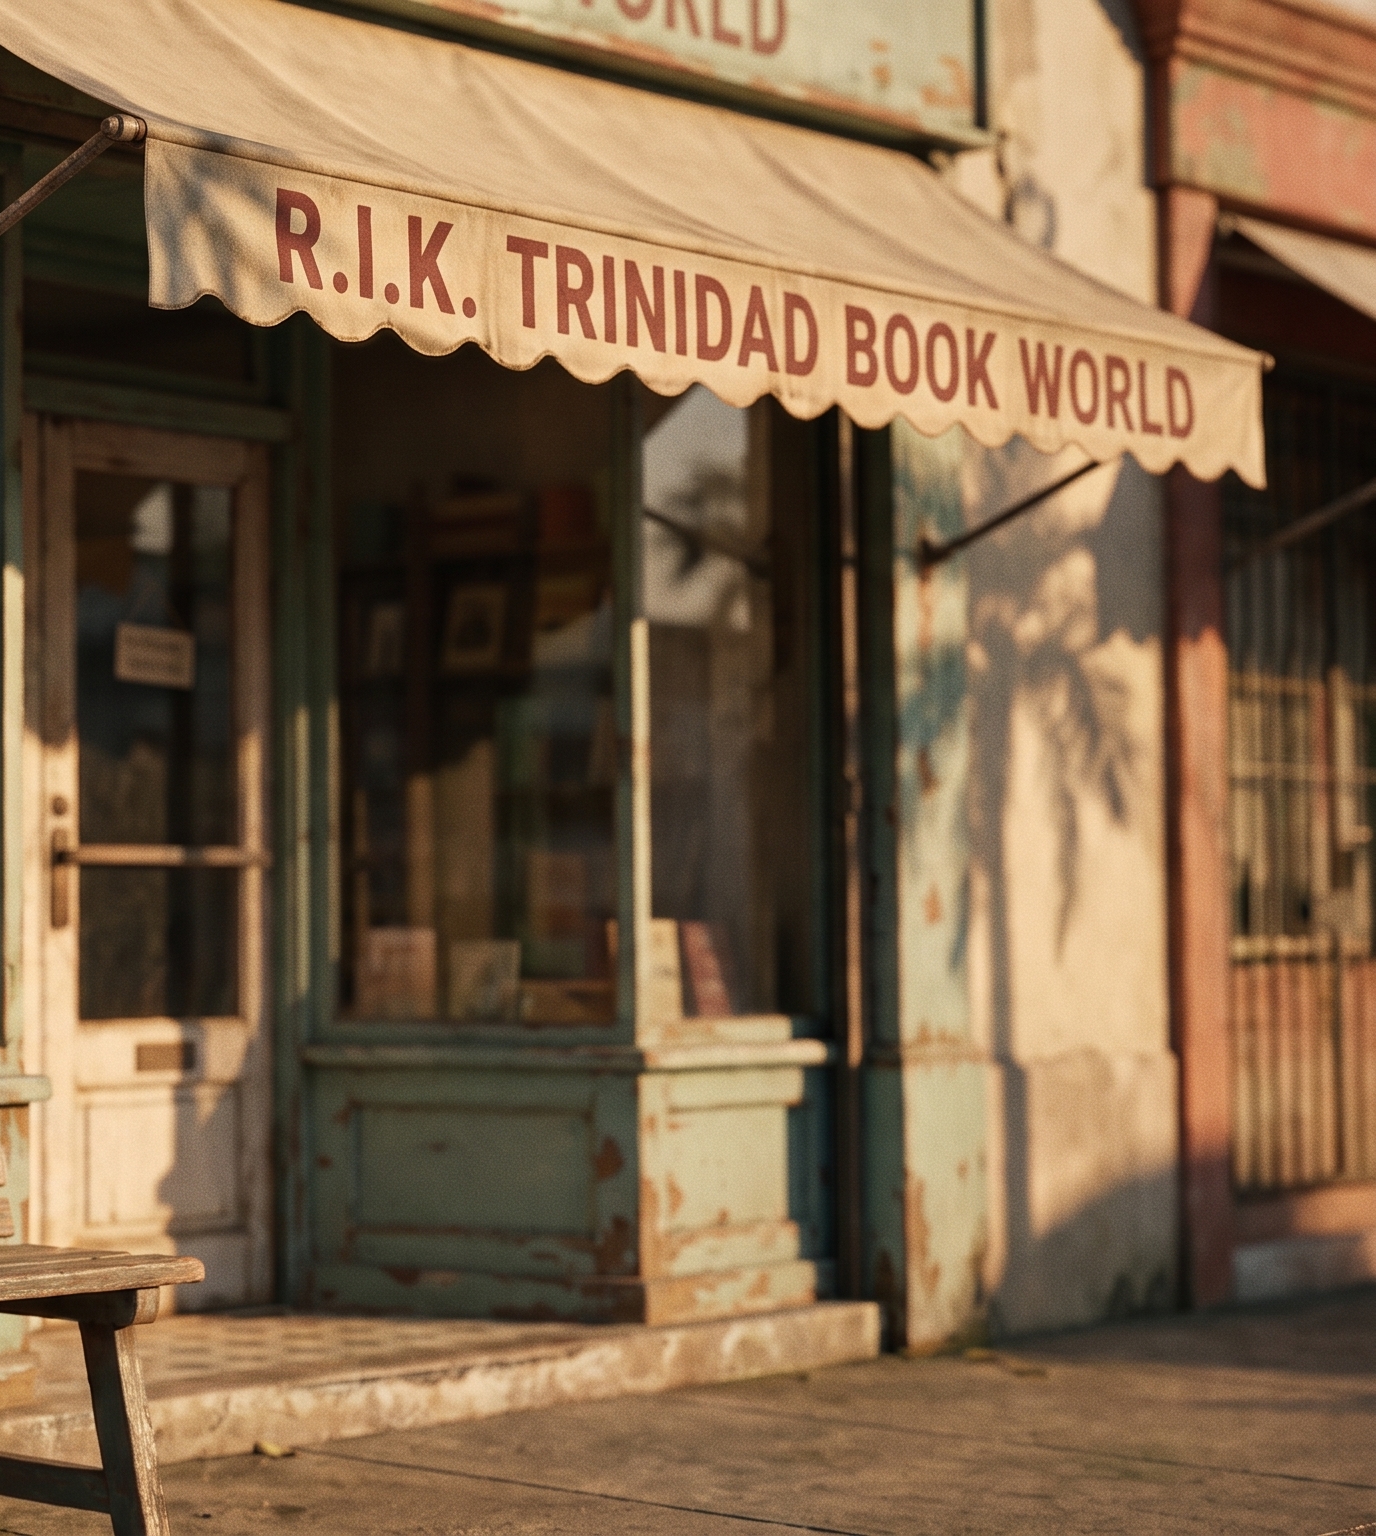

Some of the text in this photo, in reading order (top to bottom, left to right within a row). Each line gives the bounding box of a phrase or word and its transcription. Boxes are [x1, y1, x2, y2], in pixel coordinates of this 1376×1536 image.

[275, 186, 1196, 440] R.I.K. TRINIDAD BOOK WORLD
